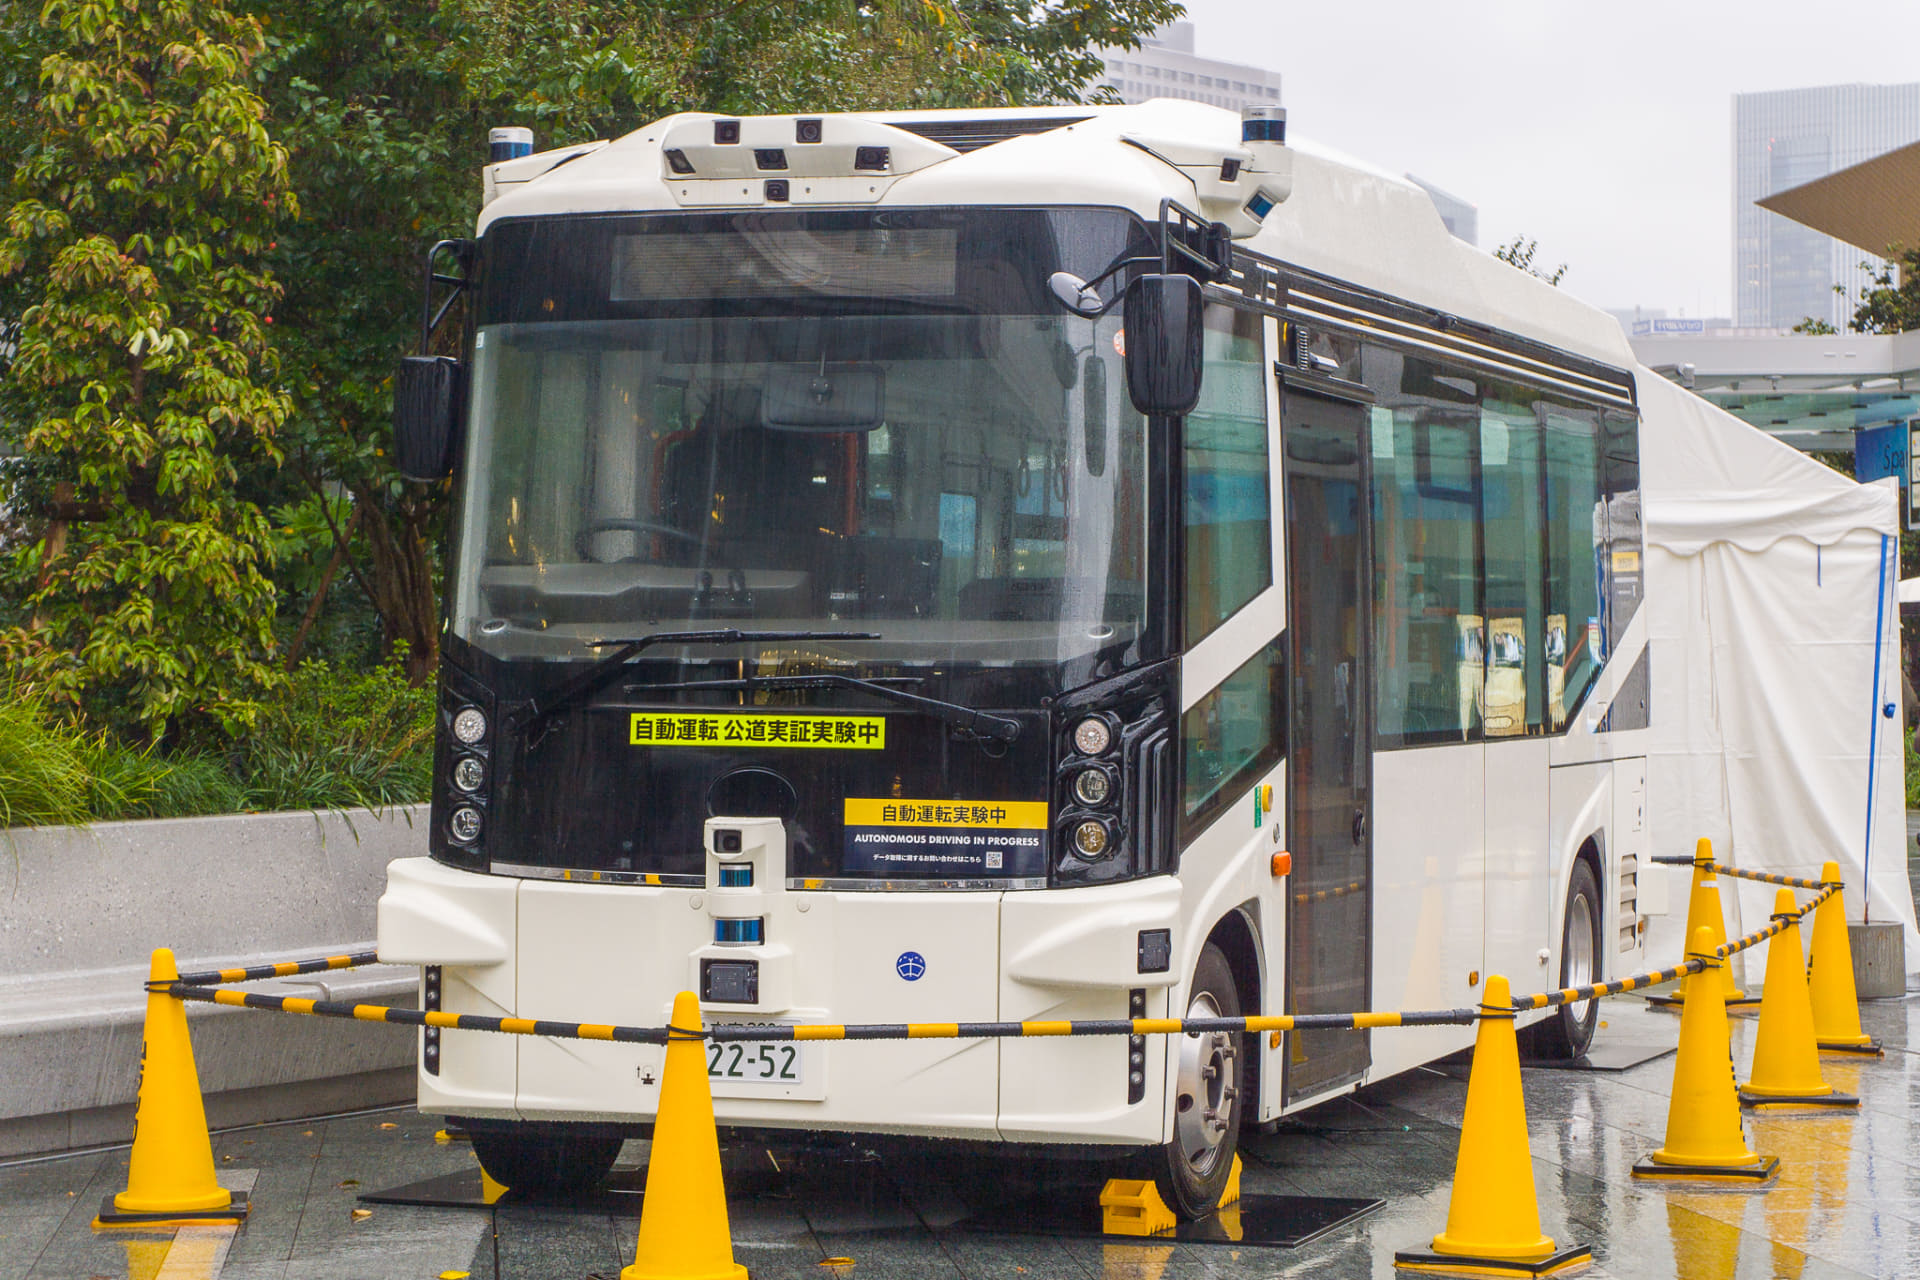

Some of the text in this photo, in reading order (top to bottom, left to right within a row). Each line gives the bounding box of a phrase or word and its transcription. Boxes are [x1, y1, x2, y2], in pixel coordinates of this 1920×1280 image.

[635, 717, 879, 744] 自動運転 公道実証実験中
[882, 804, 1006, 824] 自動運転実験中
[854, 834, 1040, 847] AUTONOMOUS DRIVING IN PROGRESS
[708, 1043, 796, 1079] 22-52
